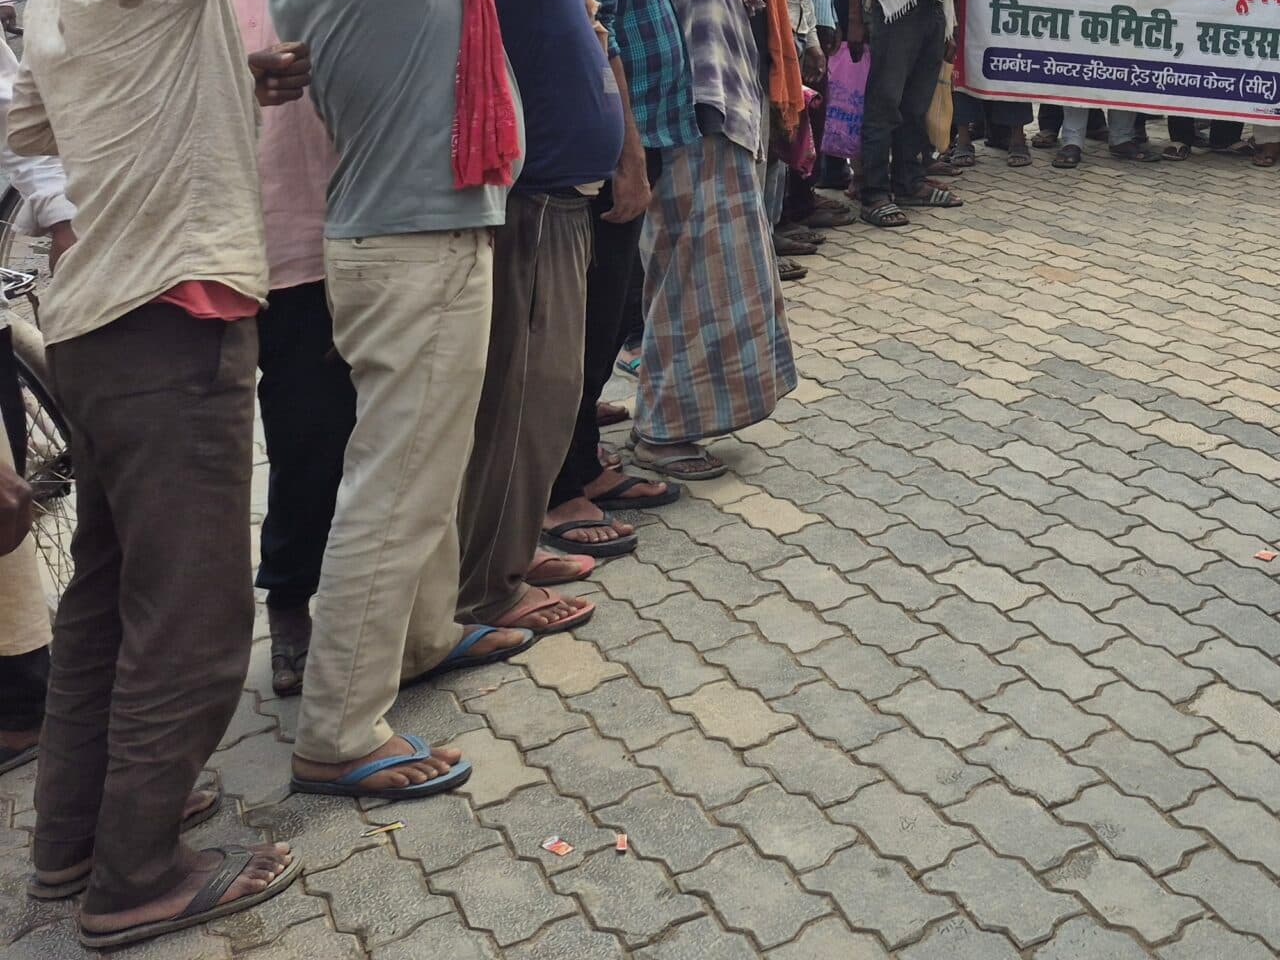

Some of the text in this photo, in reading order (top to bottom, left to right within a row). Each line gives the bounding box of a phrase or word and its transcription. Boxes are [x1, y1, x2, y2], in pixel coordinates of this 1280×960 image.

[1079, 4, 1185, 57] कमिटी,
[1043, 56, 1080, 76] सेन्टर
[1082, 57, 1128, 81] इंडियन
[1130, 63, 1150, 86] ट्रेड
[1151, 66, 1202, 91] यूनियन
[1203, 71, 1237, 93] केन्द्र
[1239, 72, 1277, 101] (सीटू)
